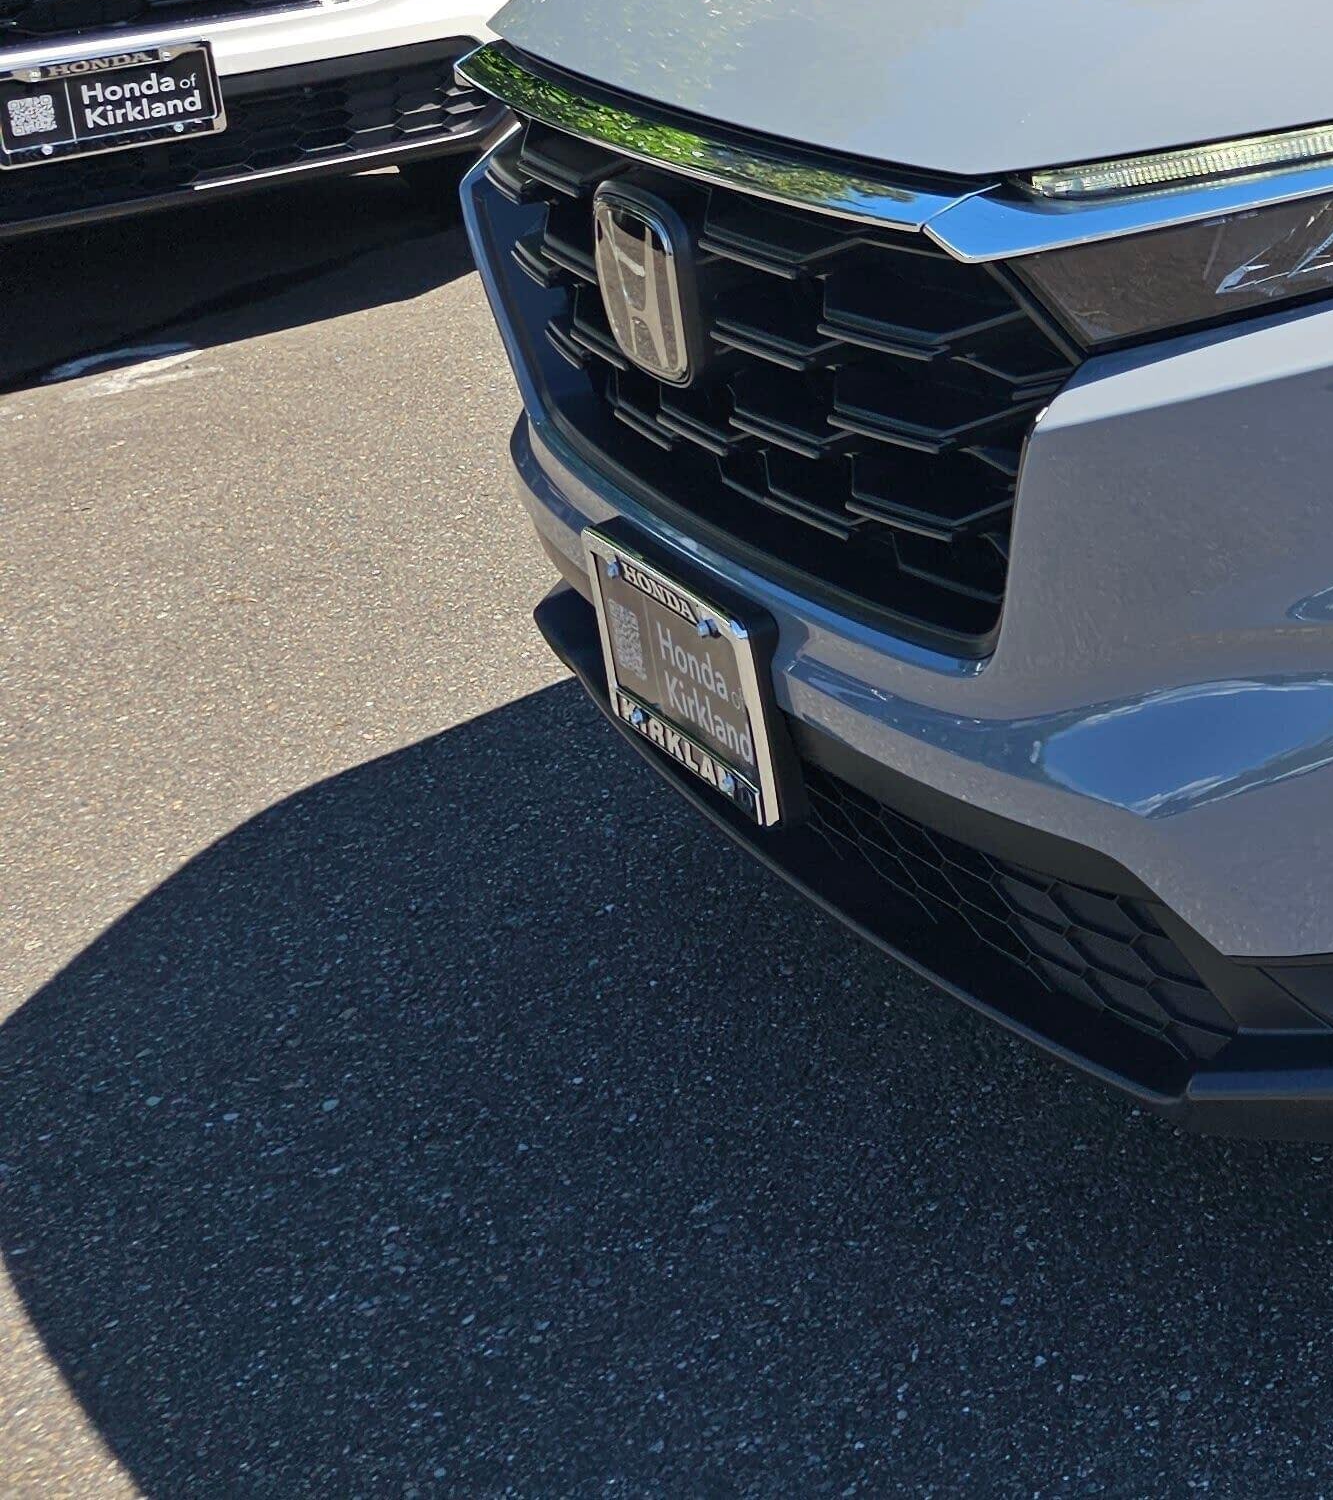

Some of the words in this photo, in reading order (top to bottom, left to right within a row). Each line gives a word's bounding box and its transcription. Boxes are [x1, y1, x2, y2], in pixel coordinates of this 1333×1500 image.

[48, 51, 152, 77] HONDA
[81, 73, 176, 105] Honda
[179, 73, 197, 89] of
[85, 90, 203, 129] Kirkland
[622, 562, 697, 623] HONDA
[656, 621, 729, 702] Honda
[664, 670, 754, 766] Kirkland
